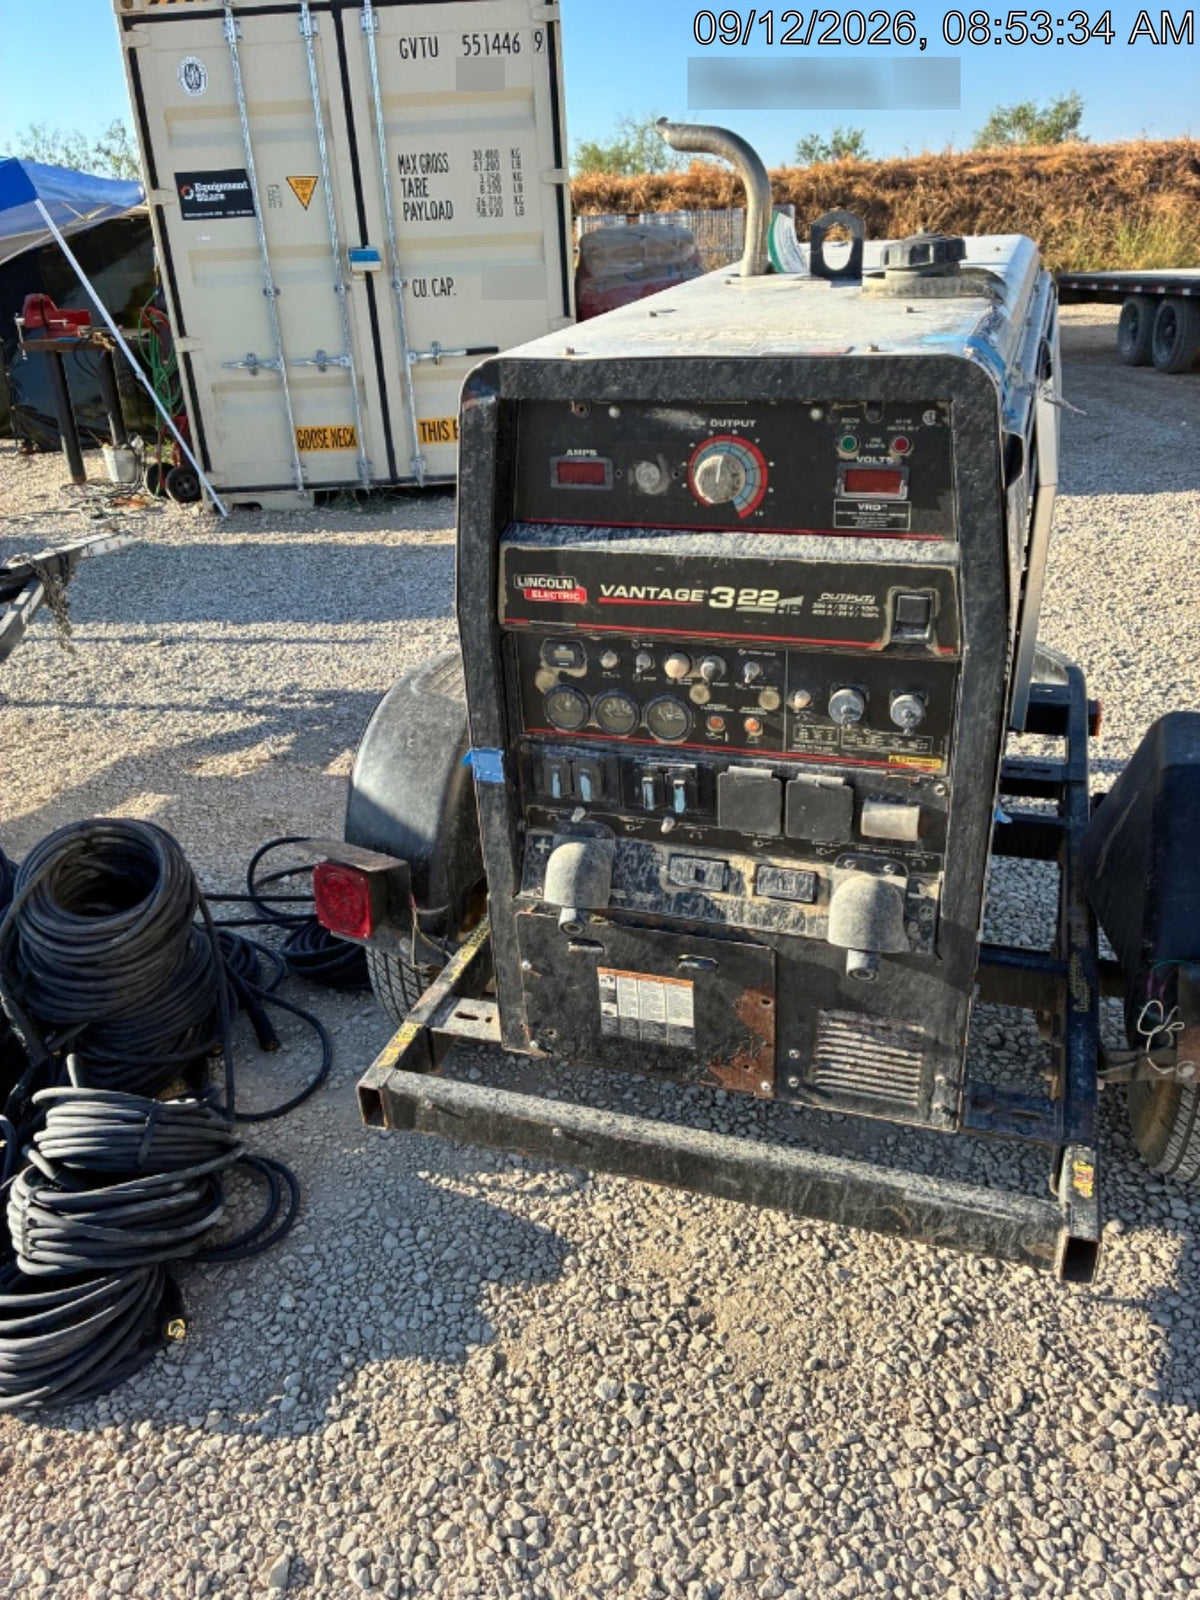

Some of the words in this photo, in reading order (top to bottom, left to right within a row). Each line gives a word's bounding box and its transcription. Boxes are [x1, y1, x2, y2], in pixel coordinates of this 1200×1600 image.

[399, 36, 439, 59] GVTU
[461, 32, 521, 56] 551446
[534, 31, 543, 53] 9
[397, 154, 417, 175] MAX
[419, 152, 449, 174] GROSS
[194, 181, 248, 193] Equipment
[400, 177, 430, 199] TARE
[403, 200, 454, 221] PAYLOAD
[431, 277, 457, 297] CAP.
[420, 420, 451, 442] THIS
[710, 419, 757, 428] OUTPUT
[297, 428, 330, 449] GOOSE
[331, 427, 358, 448] NECK
[566, 448, 598, 456] AMPS
[856, 456, 895, 464] VOLTS
[517, 576, 573, 589] LINCOLN
[531, 590, 581, 601] ELECTRIC
[708, 586, 780, 609] 322
